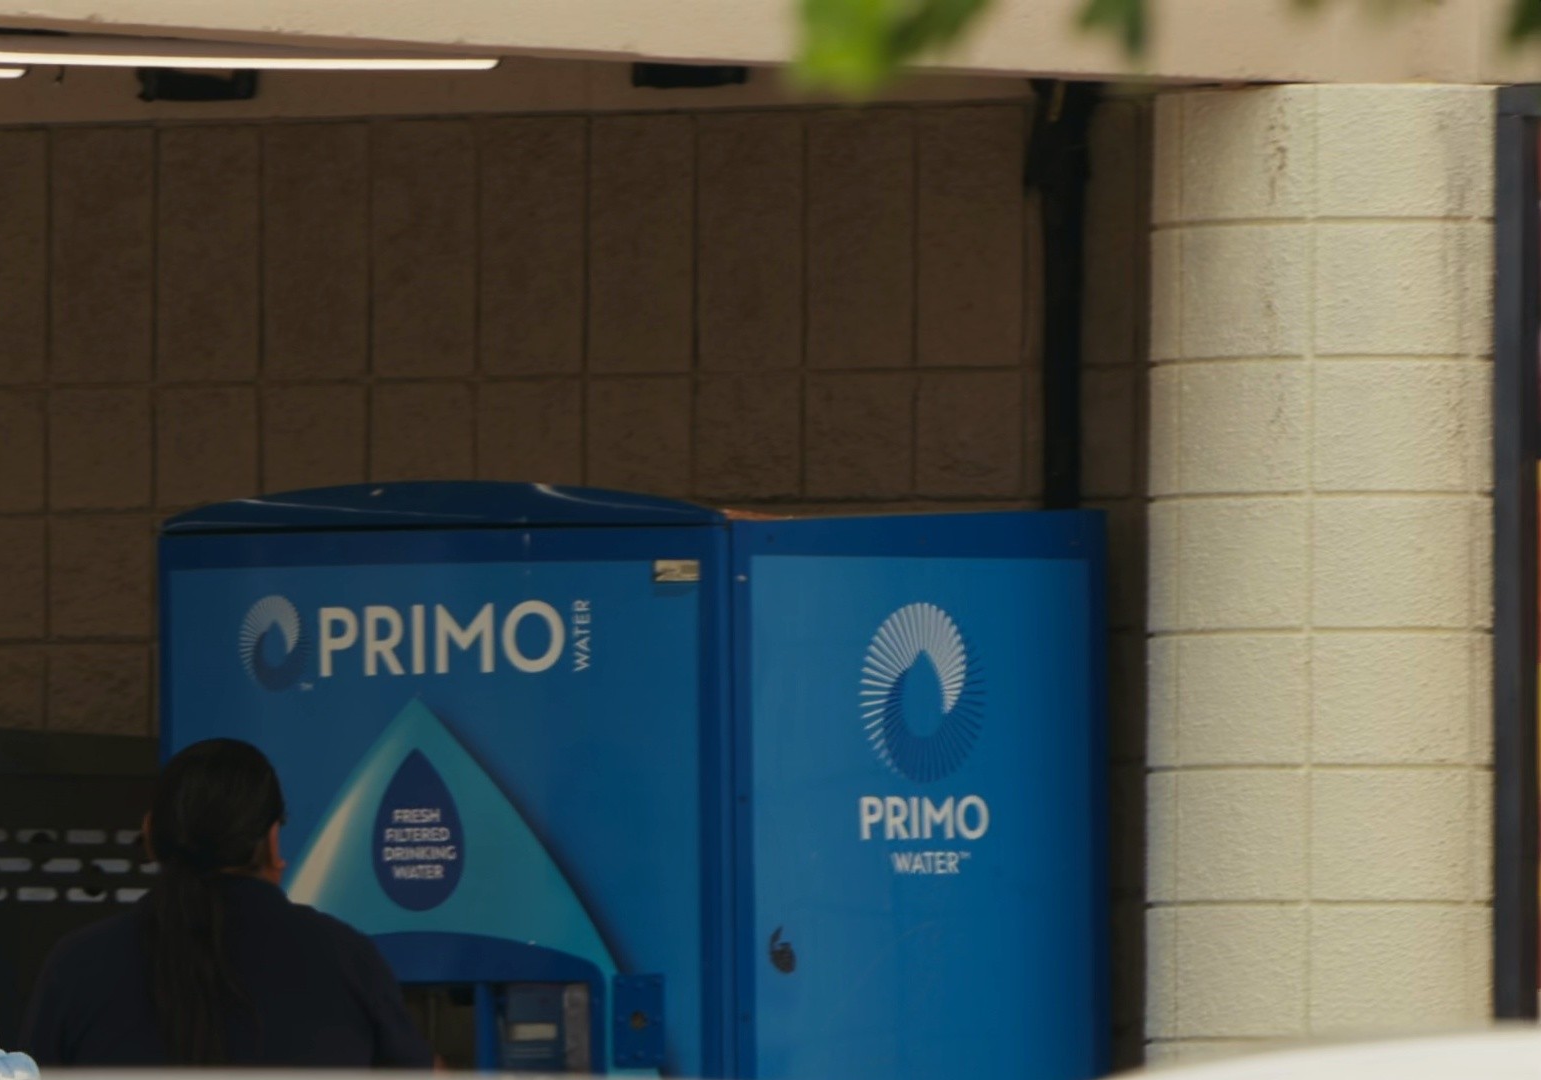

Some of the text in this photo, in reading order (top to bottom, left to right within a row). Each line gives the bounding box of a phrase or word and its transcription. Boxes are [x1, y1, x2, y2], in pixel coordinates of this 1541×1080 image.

[318, 599, 565, 677] PRIMO
[573, 599, 590, 672] WATER
[392, 808, 441, 823] FRESH
[860, 795, 990, 840] PRIMO
[384, 827, 450, 842] FILTERED
[382, 845, 457, 861] DRINKING
[393, 864, 444, 879] WATER
